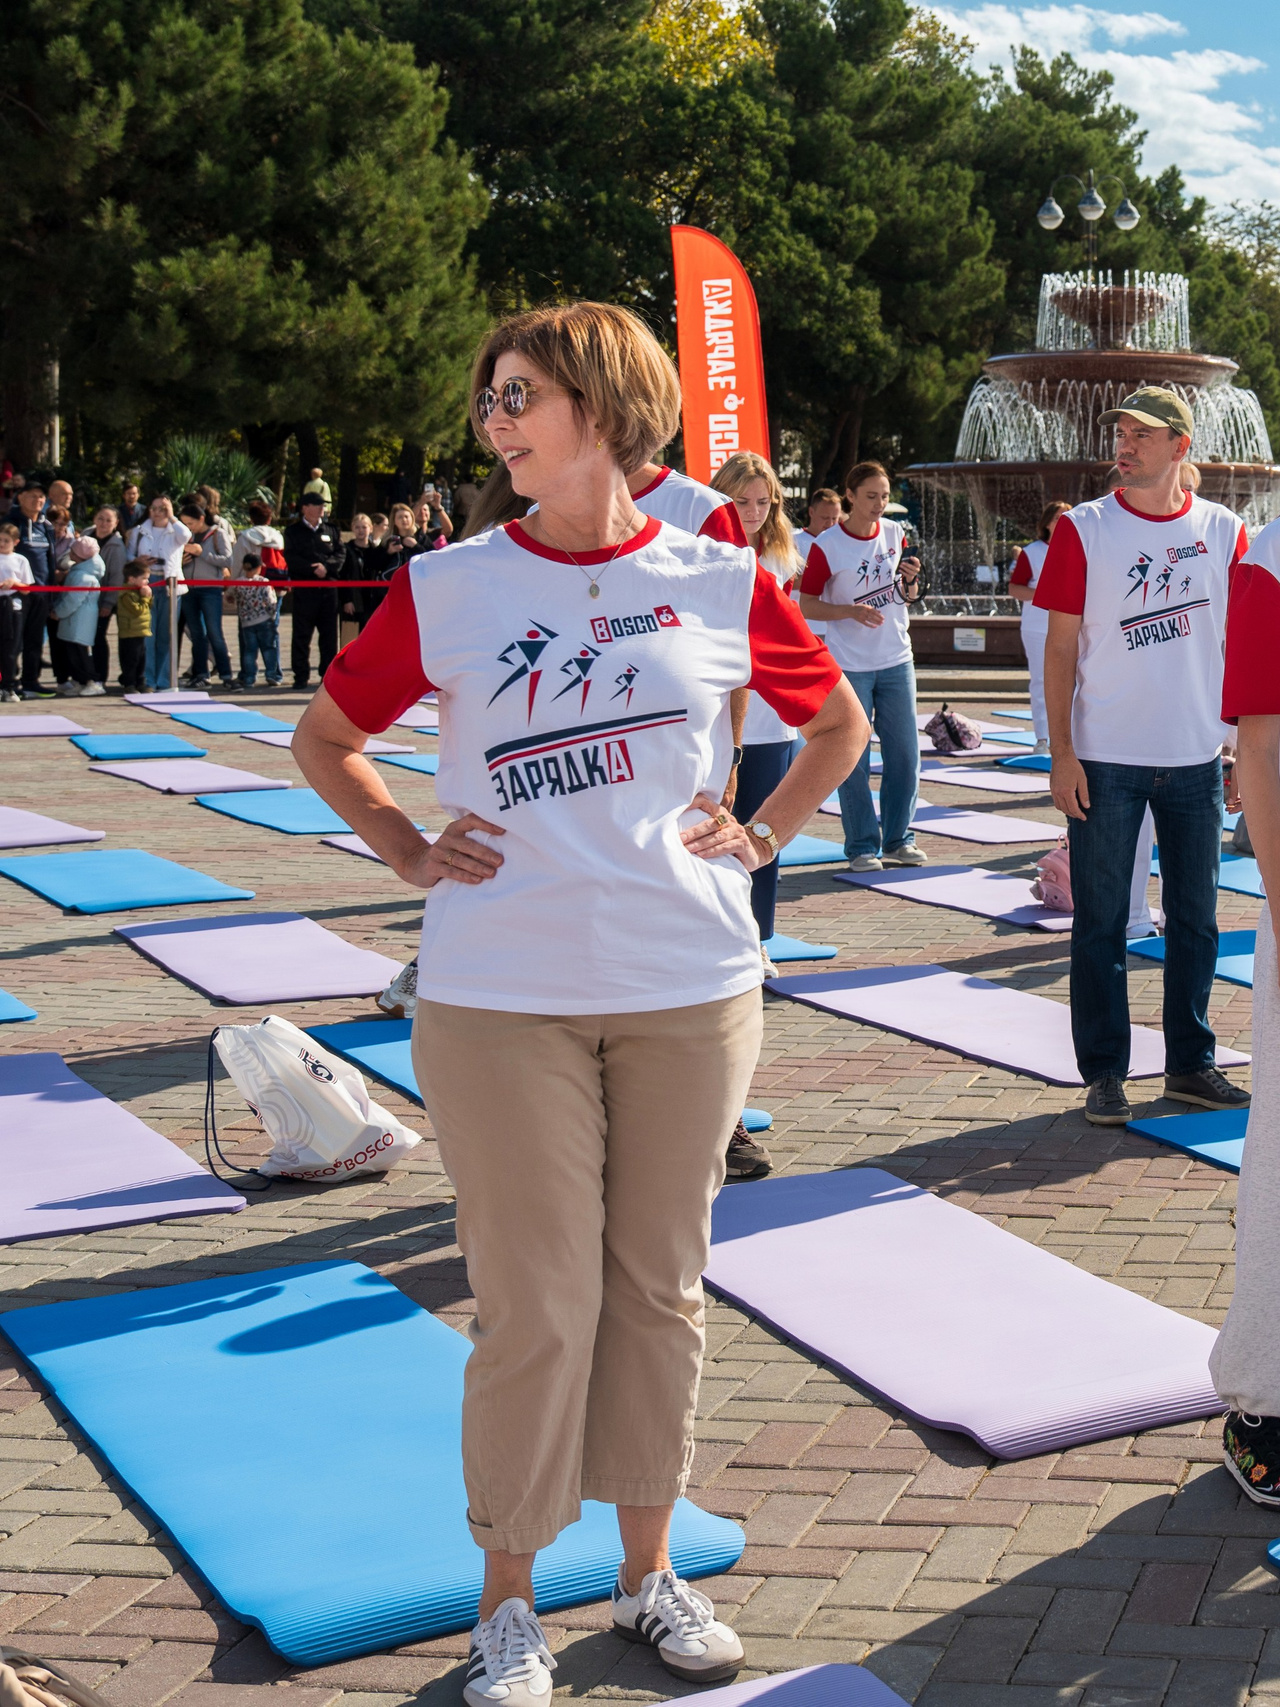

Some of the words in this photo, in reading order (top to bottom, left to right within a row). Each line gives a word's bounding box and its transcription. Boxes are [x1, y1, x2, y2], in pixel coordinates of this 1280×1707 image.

[590, 615, 659, 643] BOSCO
[1124, 614, 1191, 651] ЗАРЯДКА
[492, 739, 634, 811] ЗАРЯДКА
[343, 1132, 394, 1171] BOSCO
